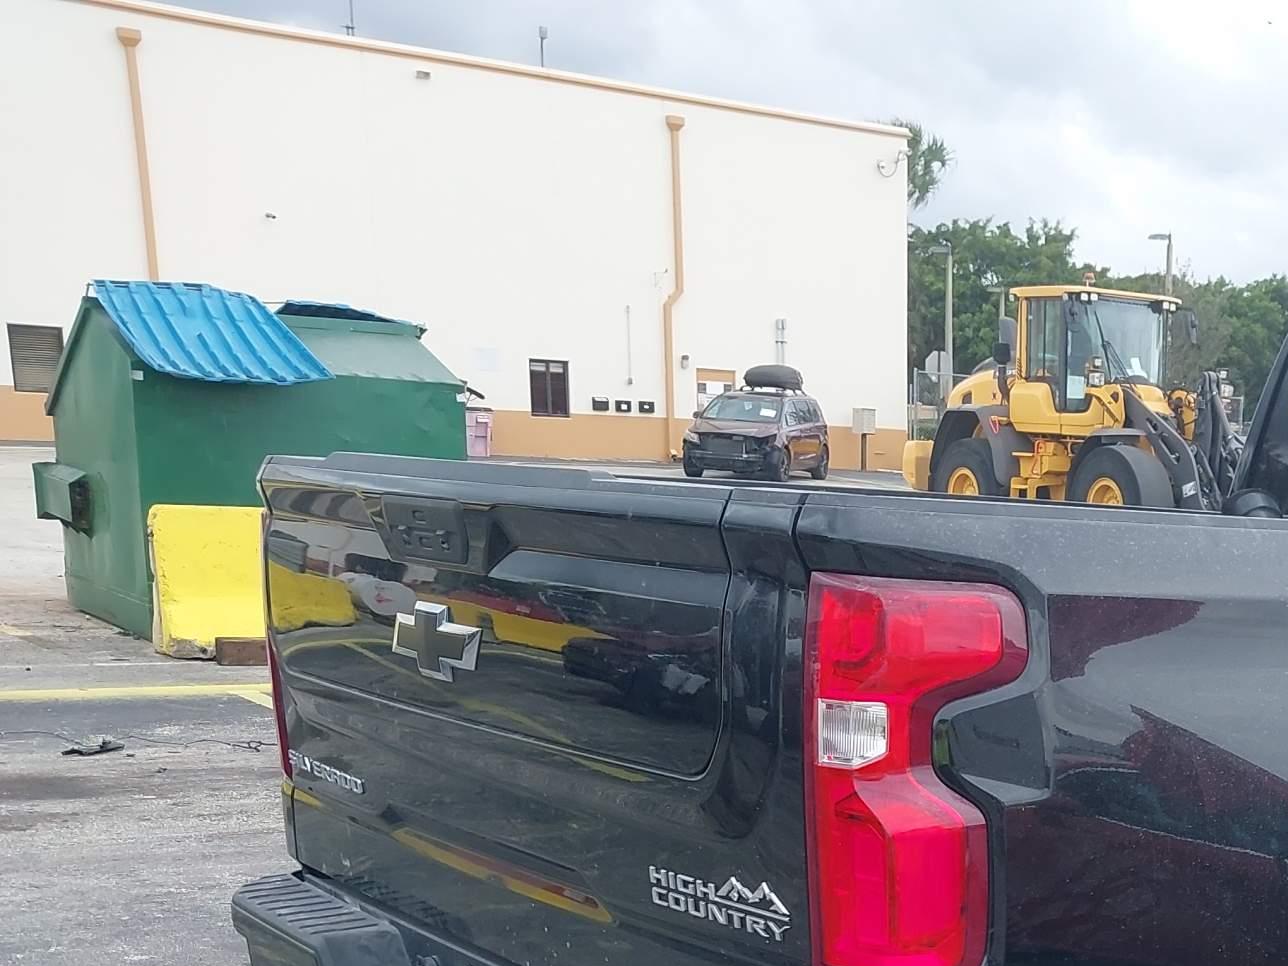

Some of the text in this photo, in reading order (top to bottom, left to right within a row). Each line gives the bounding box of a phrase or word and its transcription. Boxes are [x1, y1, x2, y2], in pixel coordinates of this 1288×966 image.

[288, 748, 365, 794] SILVERADO
[649, 865, 716, 901] HIGH
[651, 886, 791, 941] COUNTRY
